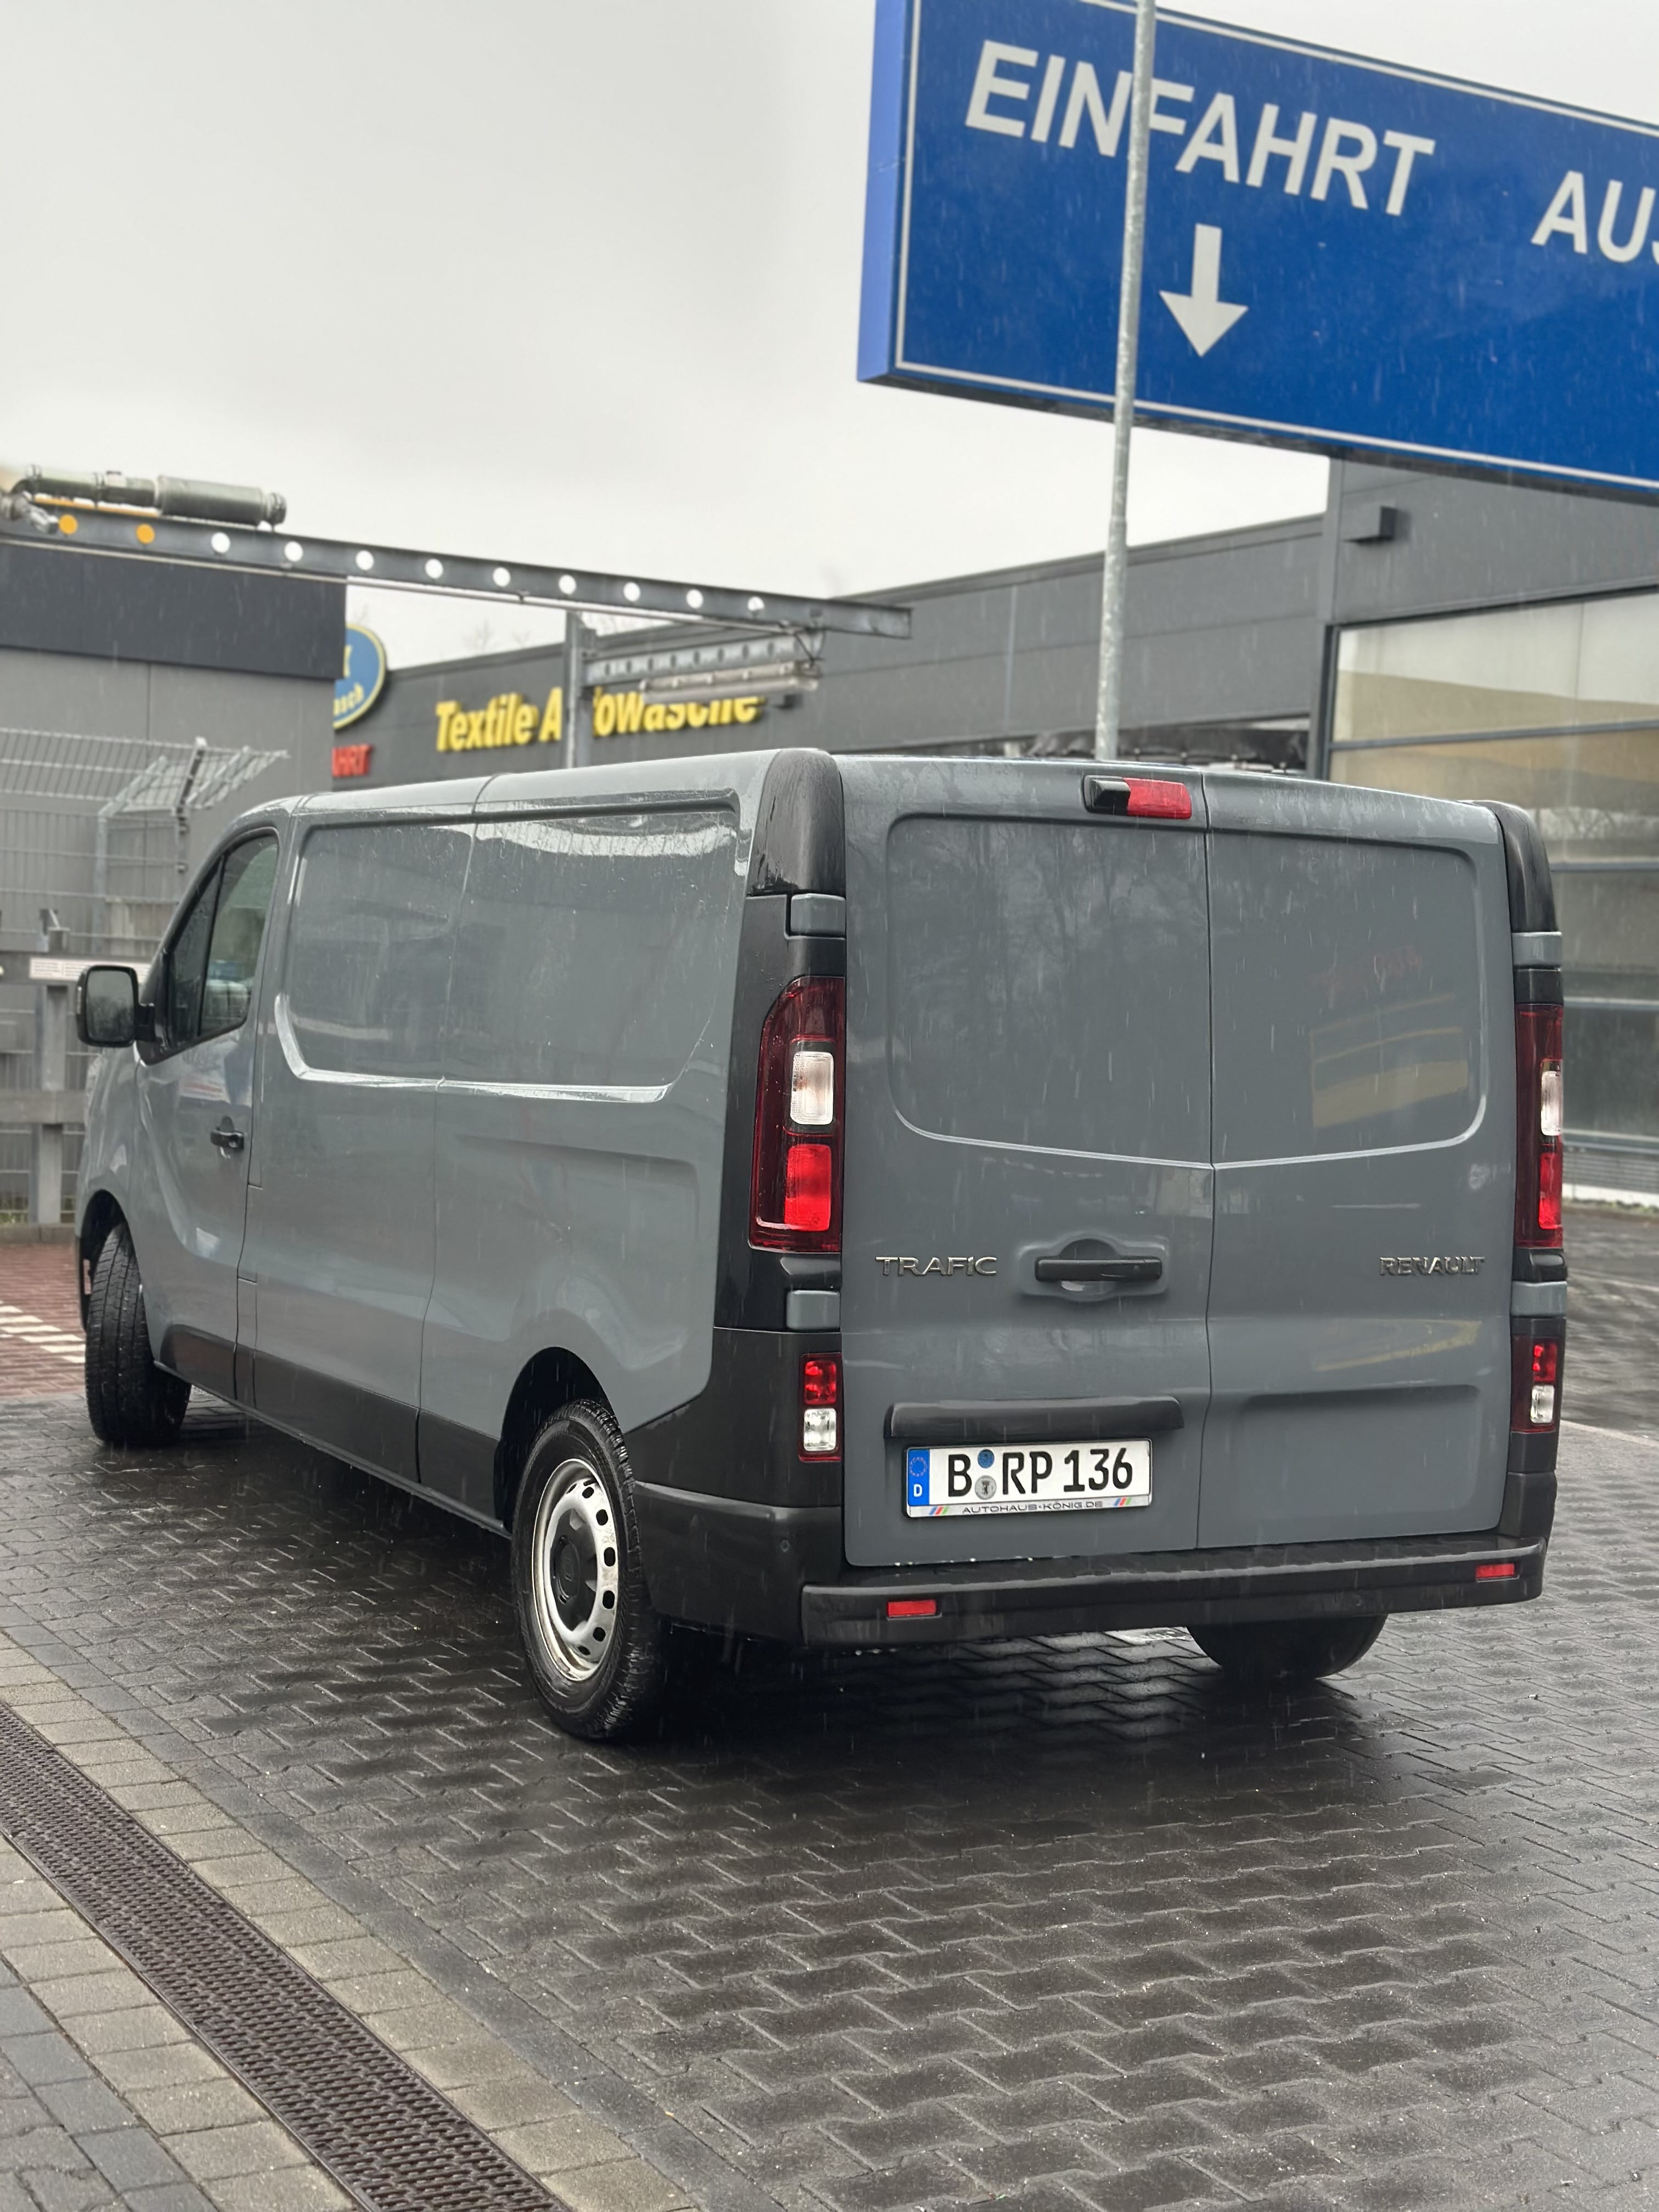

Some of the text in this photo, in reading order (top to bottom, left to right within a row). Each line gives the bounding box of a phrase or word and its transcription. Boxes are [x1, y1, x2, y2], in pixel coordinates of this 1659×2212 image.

[965, 40, 1436, 216] EINFAHRT
[1531, 170, 1659, 267] AU
[436, 692, 538, 752] Textile
[876, 1256, 997, 1276] TRAFIC
[1380, 1257, 1486, 1276] RENAULT
[913, 1483, 922, 1497] D
[948, 1447, 1133, 1497] B RP 136
